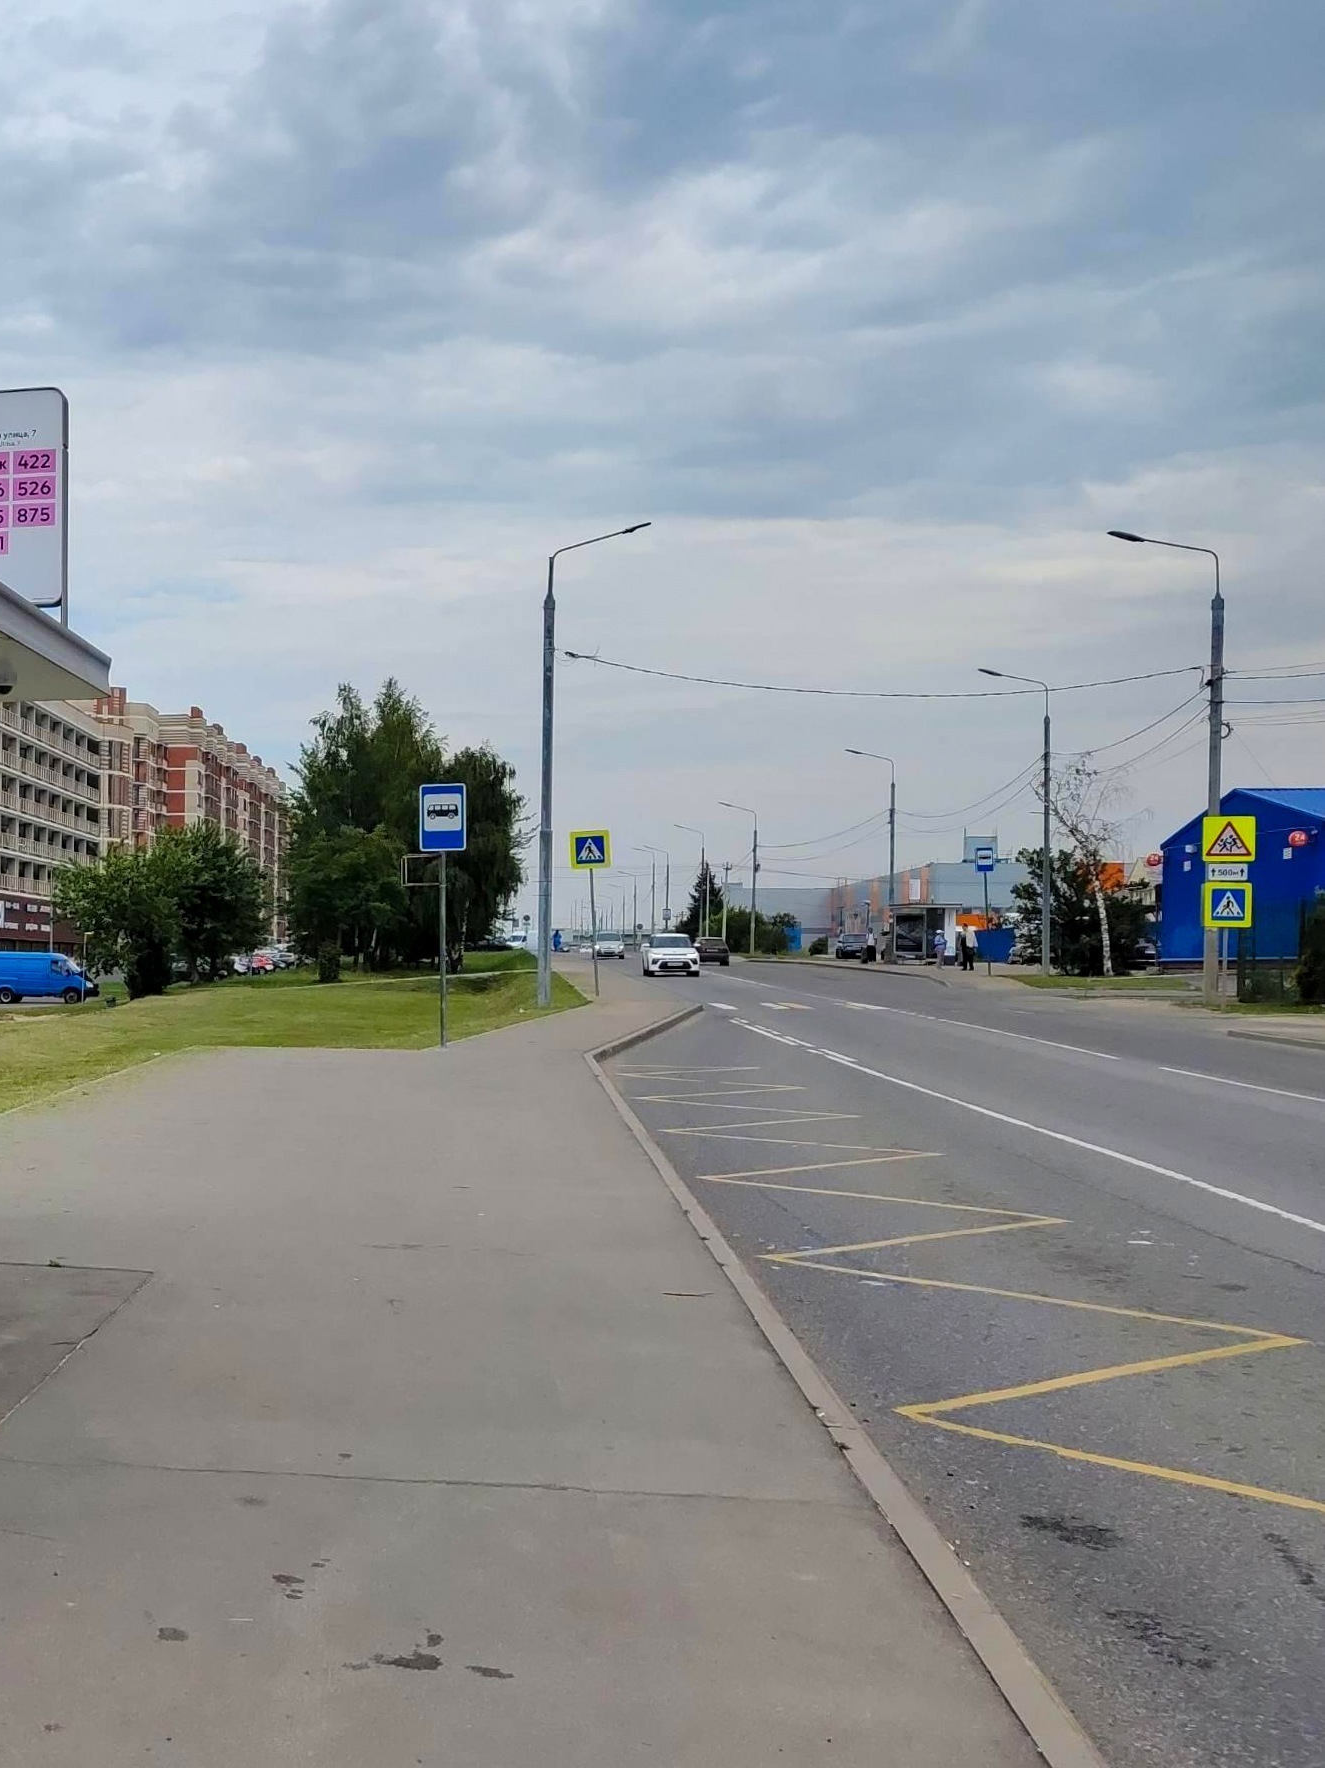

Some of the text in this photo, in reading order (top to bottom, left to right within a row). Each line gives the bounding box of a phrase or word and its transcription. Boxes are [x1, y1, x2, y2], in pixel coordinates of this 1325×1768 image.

[18, 454, 51, 470] 422
[18, 480, 51, 496] 526
[17, 508, 50, 522] 875
